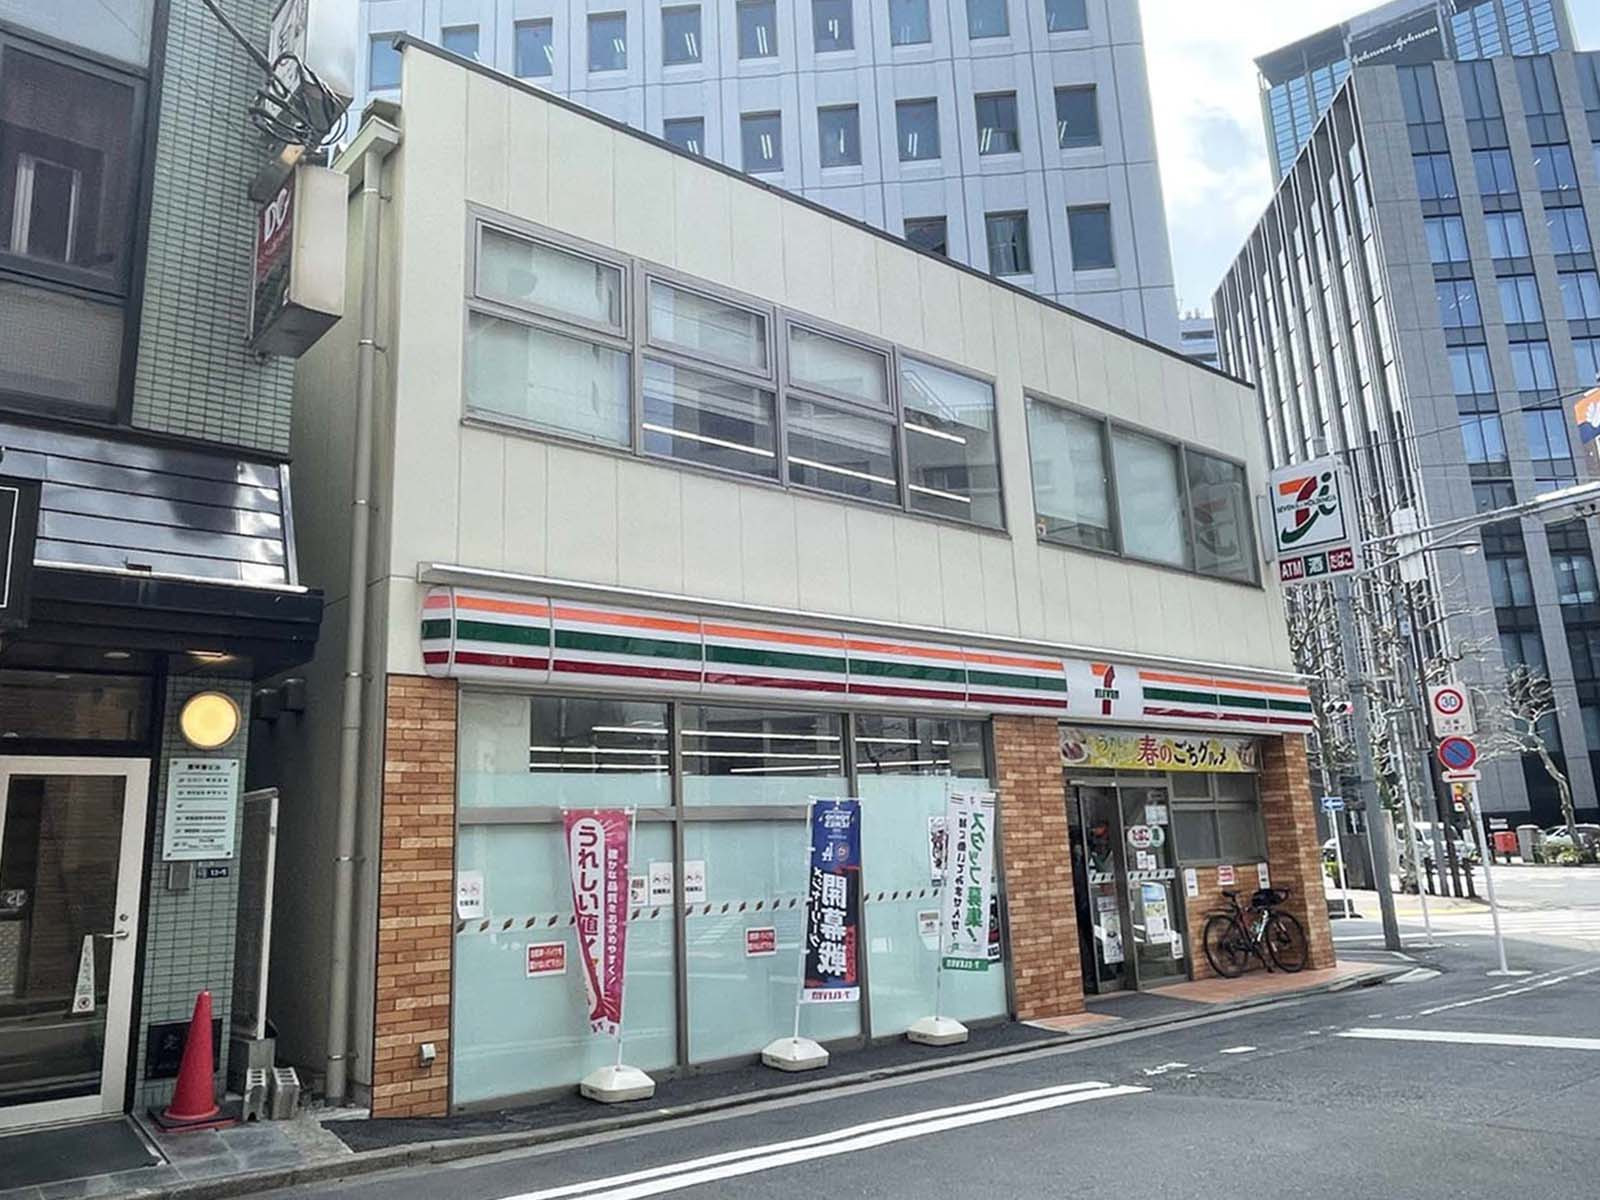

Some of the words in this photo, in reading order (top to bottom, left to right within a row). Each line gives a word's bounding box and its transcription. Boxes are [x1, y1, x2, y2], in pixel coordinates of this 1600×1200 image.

[1282, 560, 1302, 579] ATM
[1308, 555, 1324, 574] 酒
[1330, 551, 1353, 570] たばこ
[1441, 695, 1457, 709] 30
[1138, 735, 1227, 767] 春のごちグルメ
